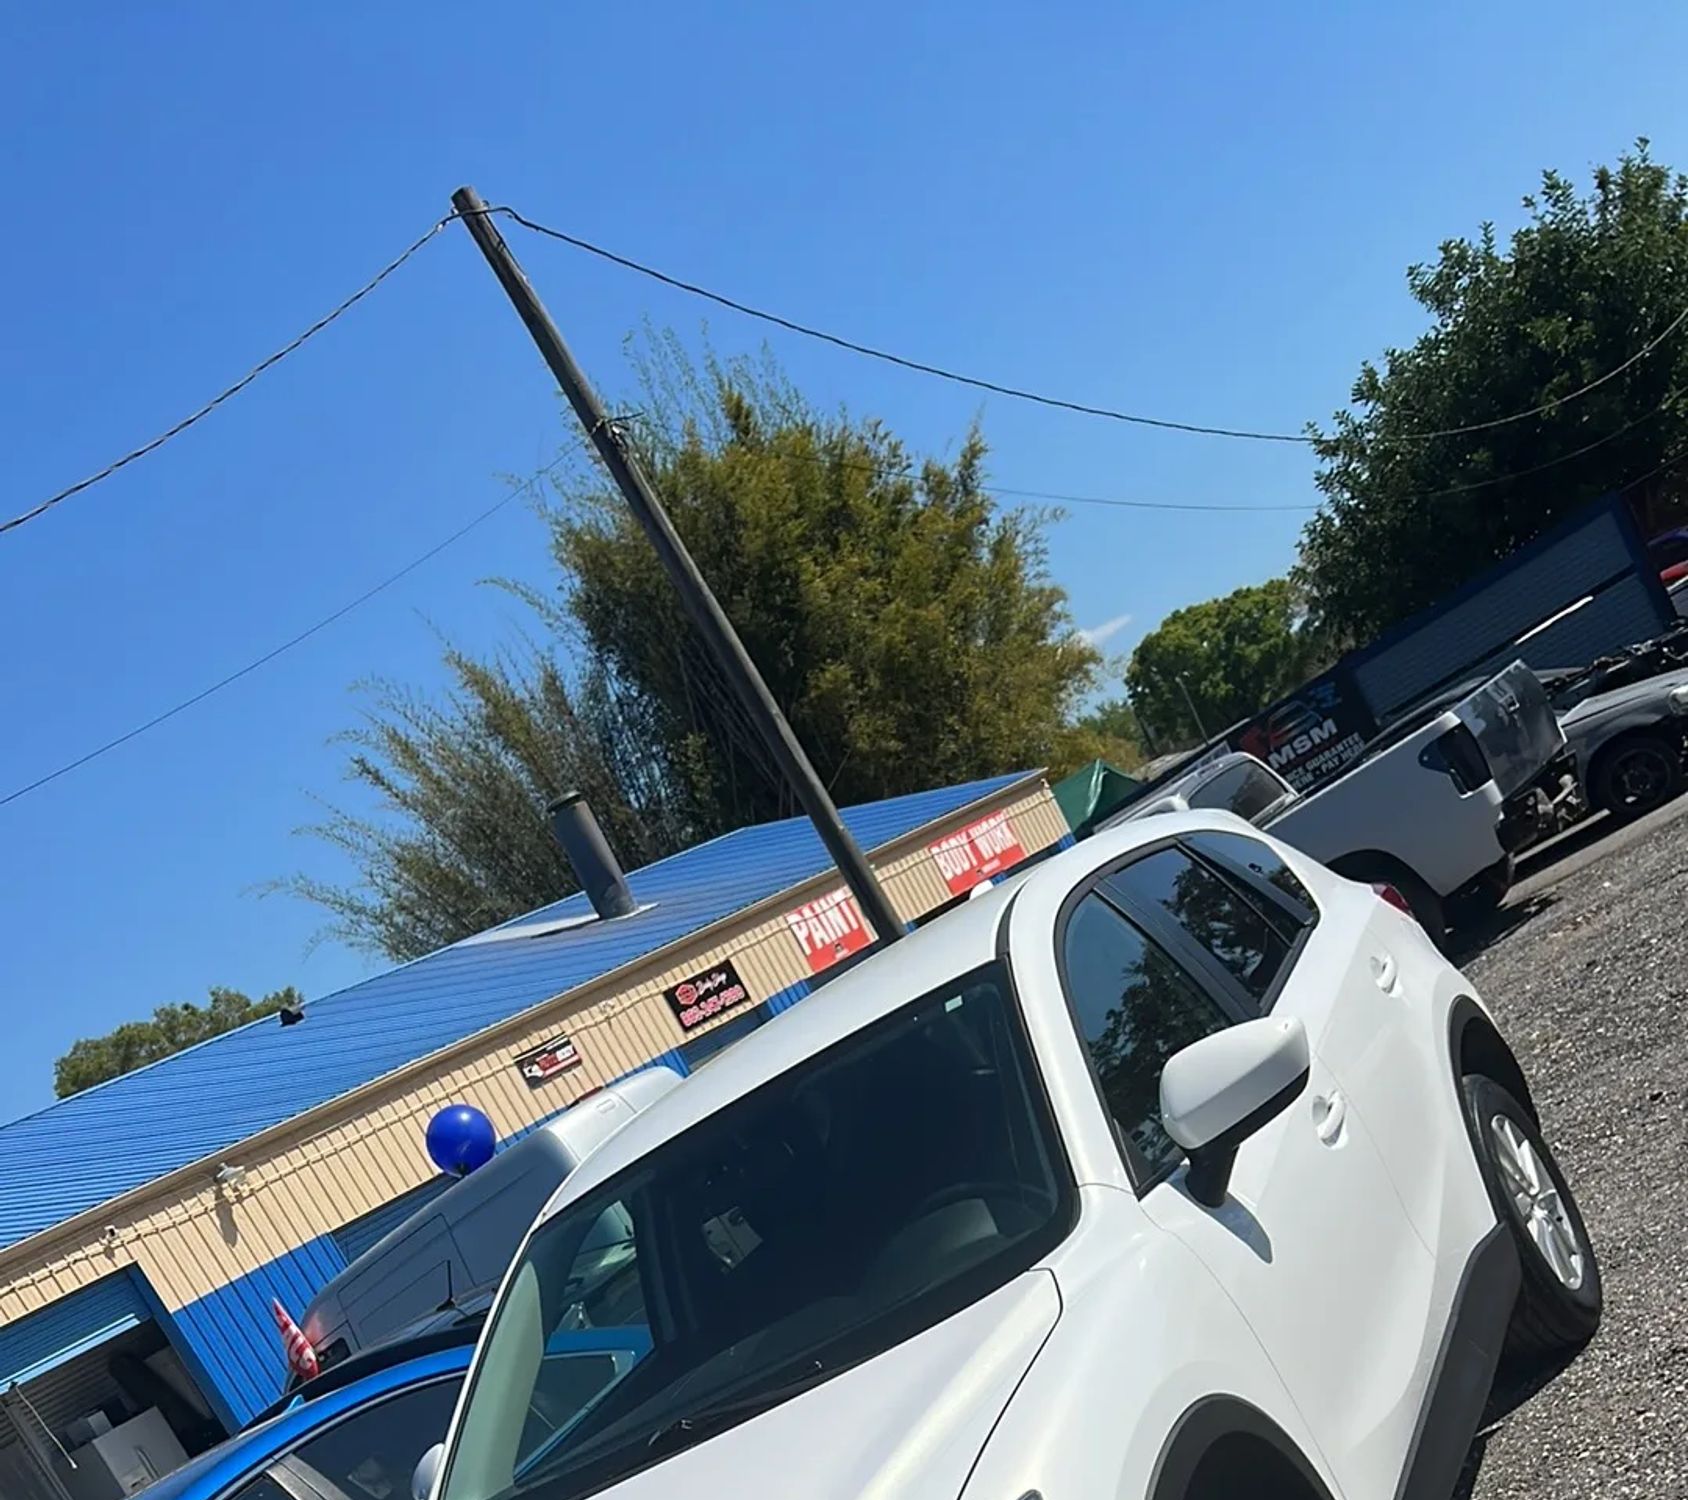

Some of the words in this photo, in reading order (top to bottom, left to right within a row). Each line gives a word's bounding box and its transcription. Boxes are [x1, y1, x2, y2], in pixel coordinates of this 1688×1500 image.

[1268, 718, 1337, 769] MSM
[1305, 732, 1361, 770] GUARANTEE
[1321, 756, 1339, 773] PAY
[930, 831, 978, 881] BODY
[968, 813, 1019, 860] WORK
[786, 885, 860, 956] PAINT
